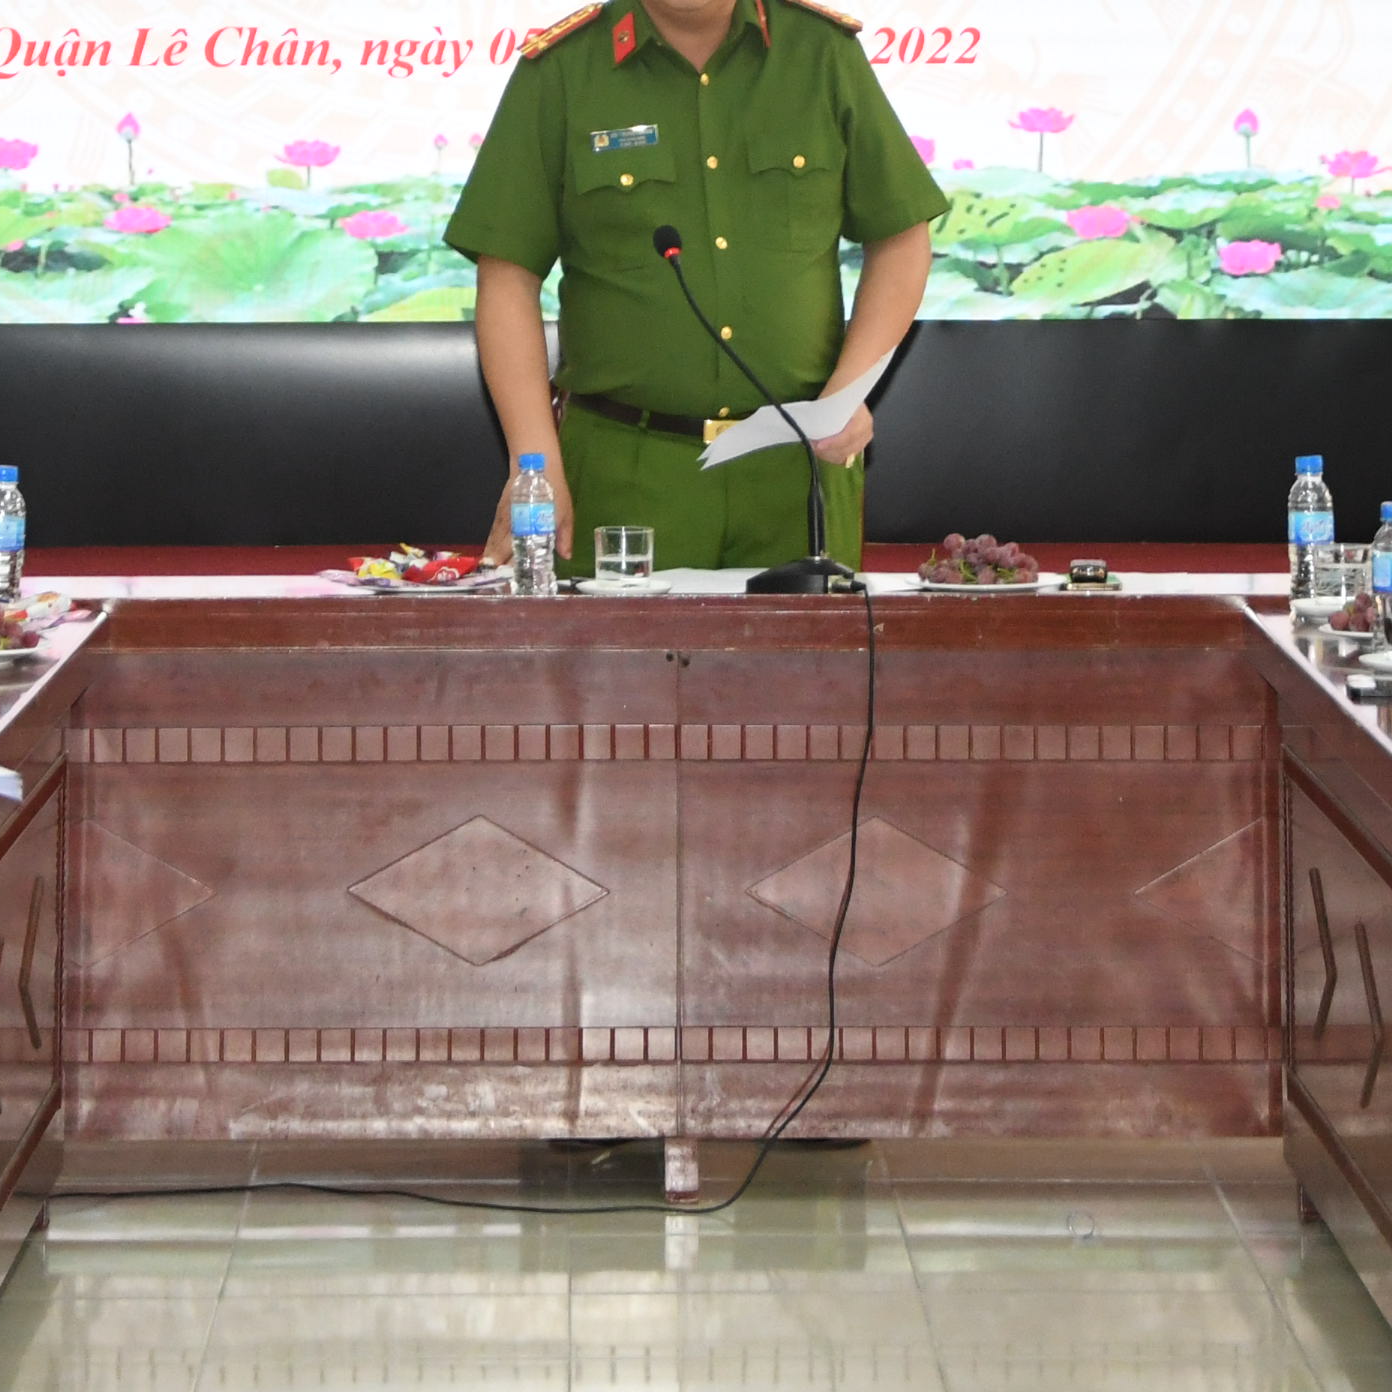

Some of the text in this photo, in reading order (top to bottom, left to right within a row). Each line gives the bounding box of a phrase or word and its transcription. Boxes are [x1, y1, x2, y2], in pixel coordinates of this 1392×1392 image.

[128, 26, 189, 68] Lê
[203, 26, 343, 74] Chân,
[359, 26, 475, 78] ngày
[869, 26, 982, 65] 2022
